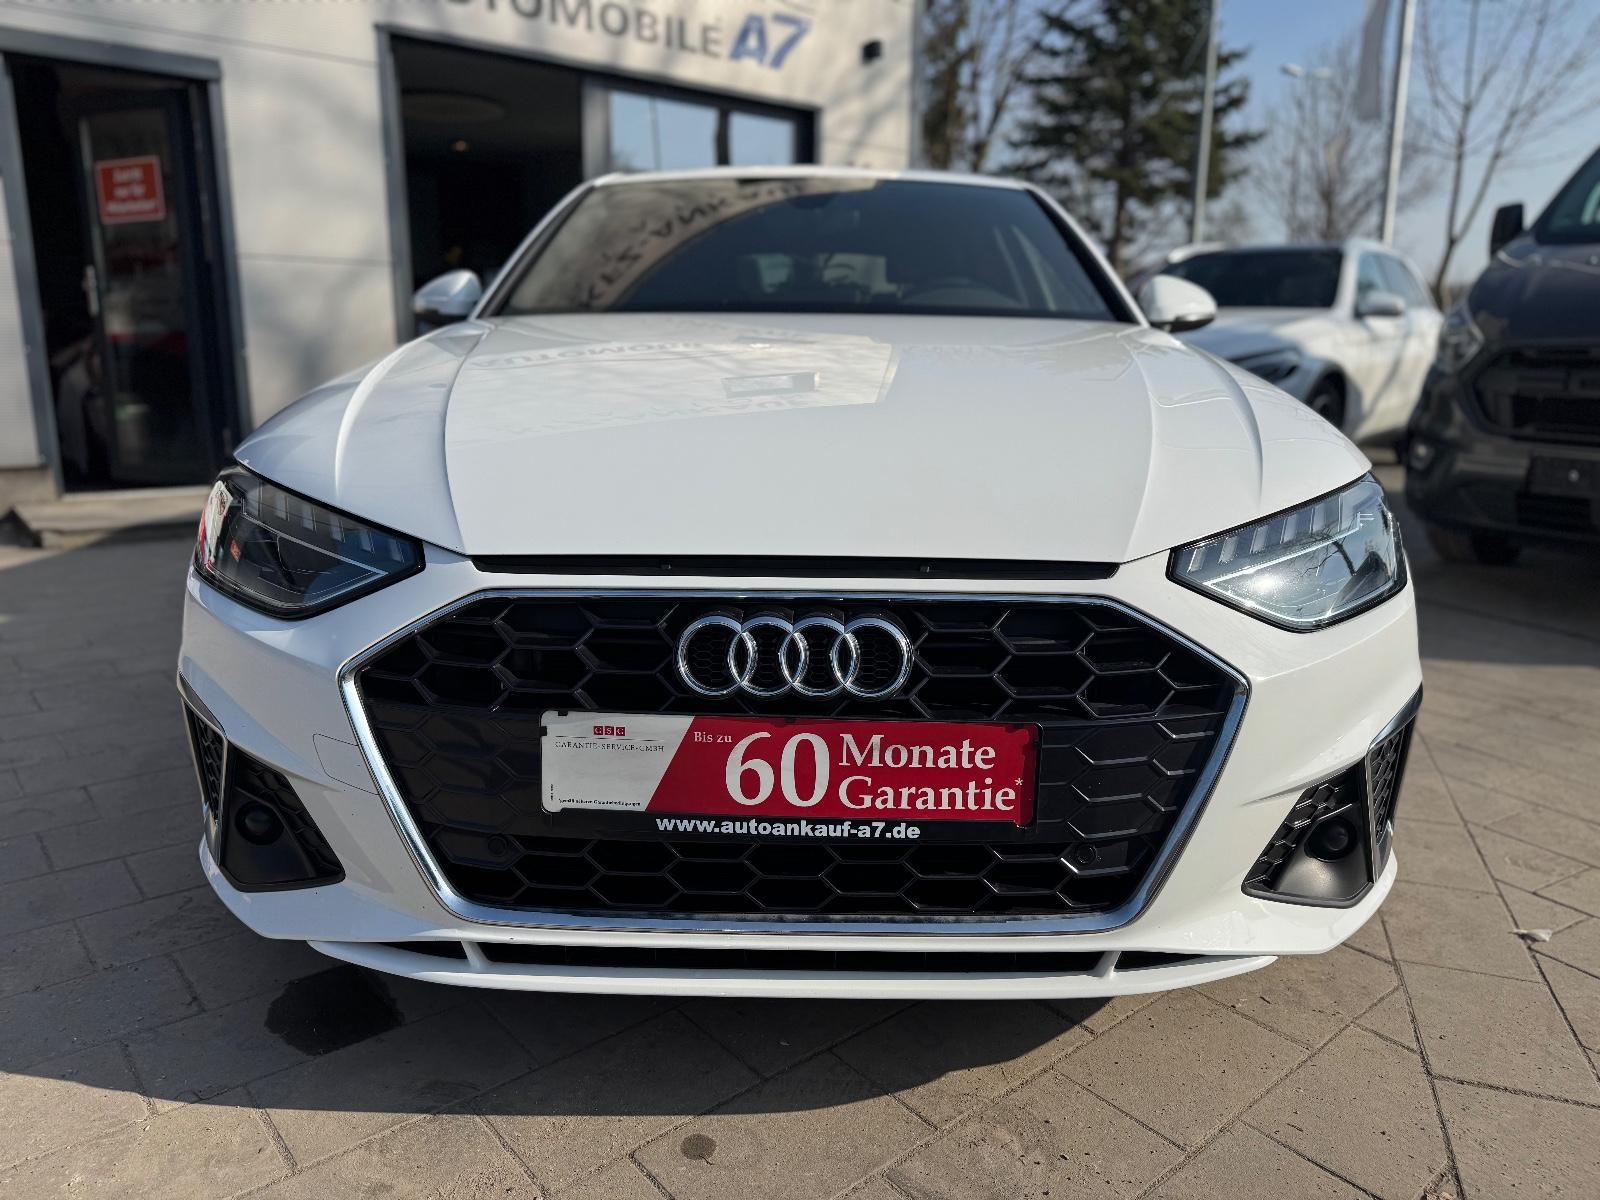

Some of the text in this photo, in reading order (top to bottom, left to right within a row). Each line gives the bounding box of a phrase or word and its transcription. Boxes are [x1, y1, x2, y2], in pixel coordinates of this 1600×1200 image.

[728, 11, 813, 70] A7
[593, 725, 626, 736] GSG
[693, 731, 733, 743] Bis zu
[838, 733, 996, 770] Monate
[725, 731, 830, 807] 60
[655, 818, 921, 840] www.autoankauf-a7.de
